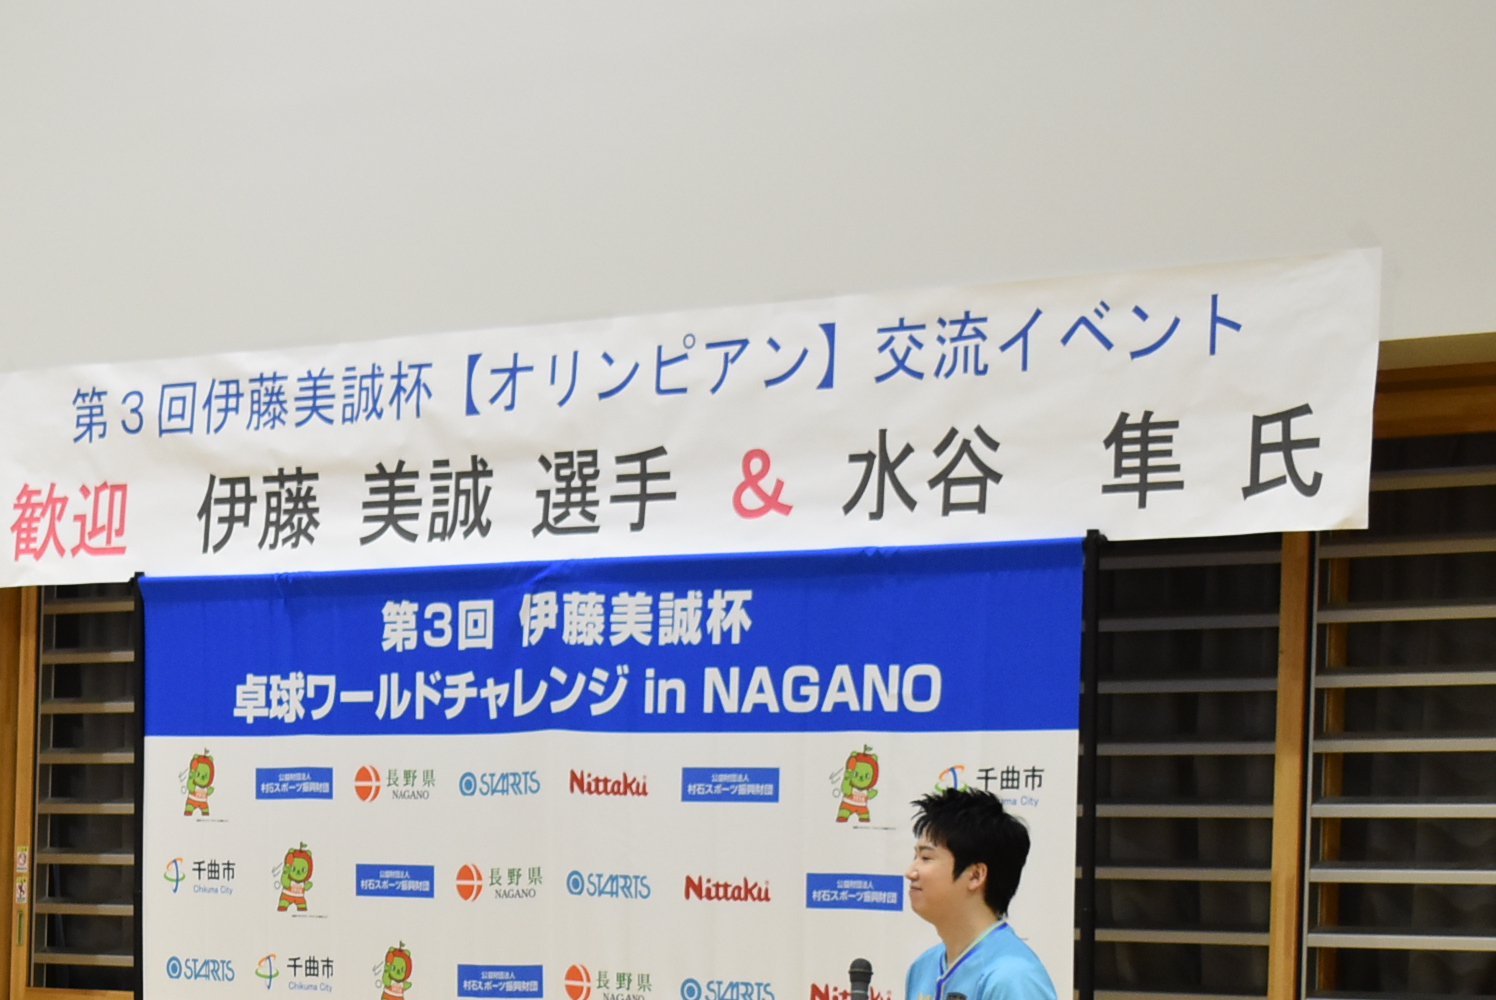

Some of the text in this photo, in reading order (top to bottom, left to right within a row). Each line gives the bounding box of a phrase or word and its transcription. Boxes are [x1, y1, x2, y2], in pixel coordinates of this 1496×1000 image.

[10, 403, 1324, 562] 歓迎 伊藤 美誠 選手 & 水谷 隼 氏
[381, 589, 752, 653] 第3回 伊藤美誠杯
[233, 664, 942, 724] 卓球ワールドチャレンジ in NAGANO
[386, 767, 436, 788] 長野県
[569, 769, 648, 797] Nittaku
[976, 765, 1045, 791] 千曲市
[391, 789, 430, 801] NAGANO
[1020, 796, 1039, 807] City
[191, 859, 236, 881] 千曲市
[488, 867, 543, 887] 長野県
[193, 885, 233, 895] Chikuma City
[495, 888, 536, 899] NAGANO
[685, 875, 770, 903] Nittaku
[287, 955, 334, 979] 千曲市
[288, 981, 333, 993] Chikuma City
[596, 970, 652, 993] 長野県
